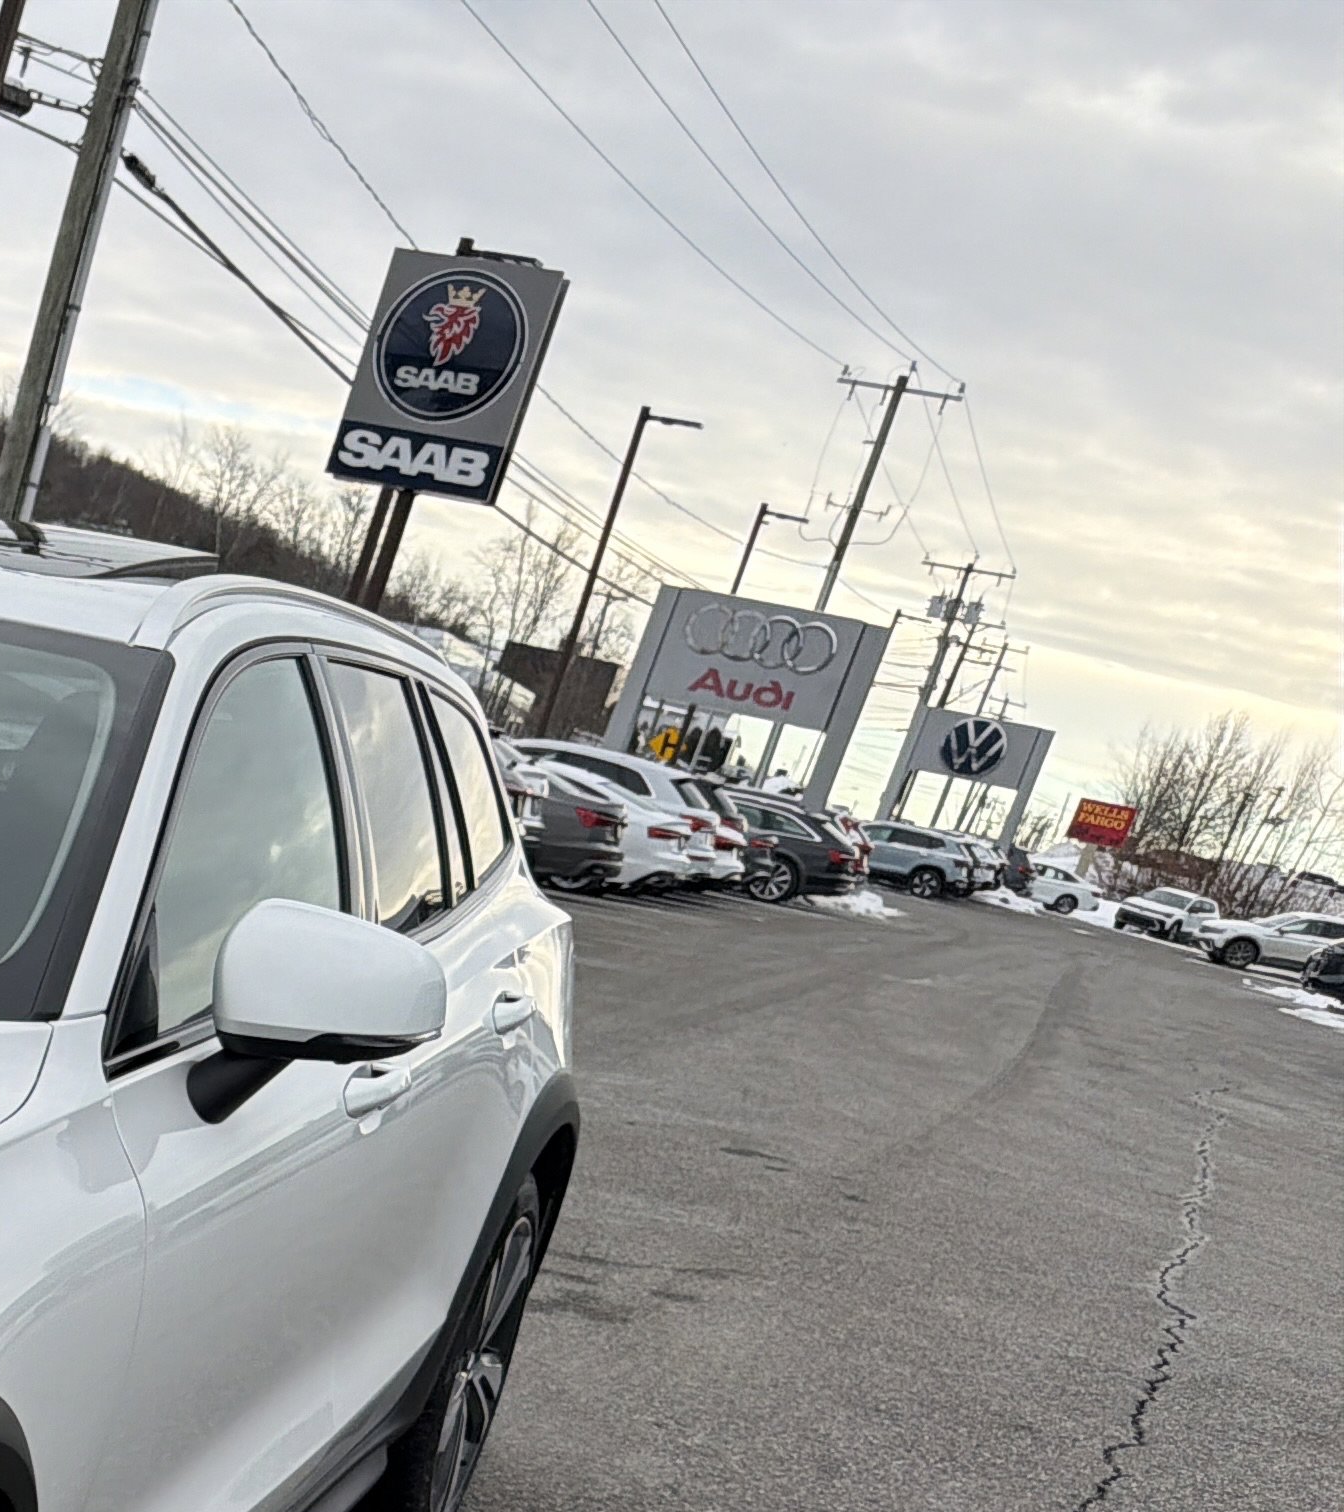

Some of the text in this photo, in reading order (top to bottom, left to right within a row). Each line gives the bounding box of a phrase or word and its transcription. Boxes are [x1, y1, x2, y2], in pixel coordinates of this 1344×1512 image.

[393, 365, 481, 396] SAAB
[337, 428, 490, 488] SAAB
[687, 666, 797, 712] Audi
[1077, 811, 1127, 832] FARGO
[1082, 801, 1130, 821] WELLS
